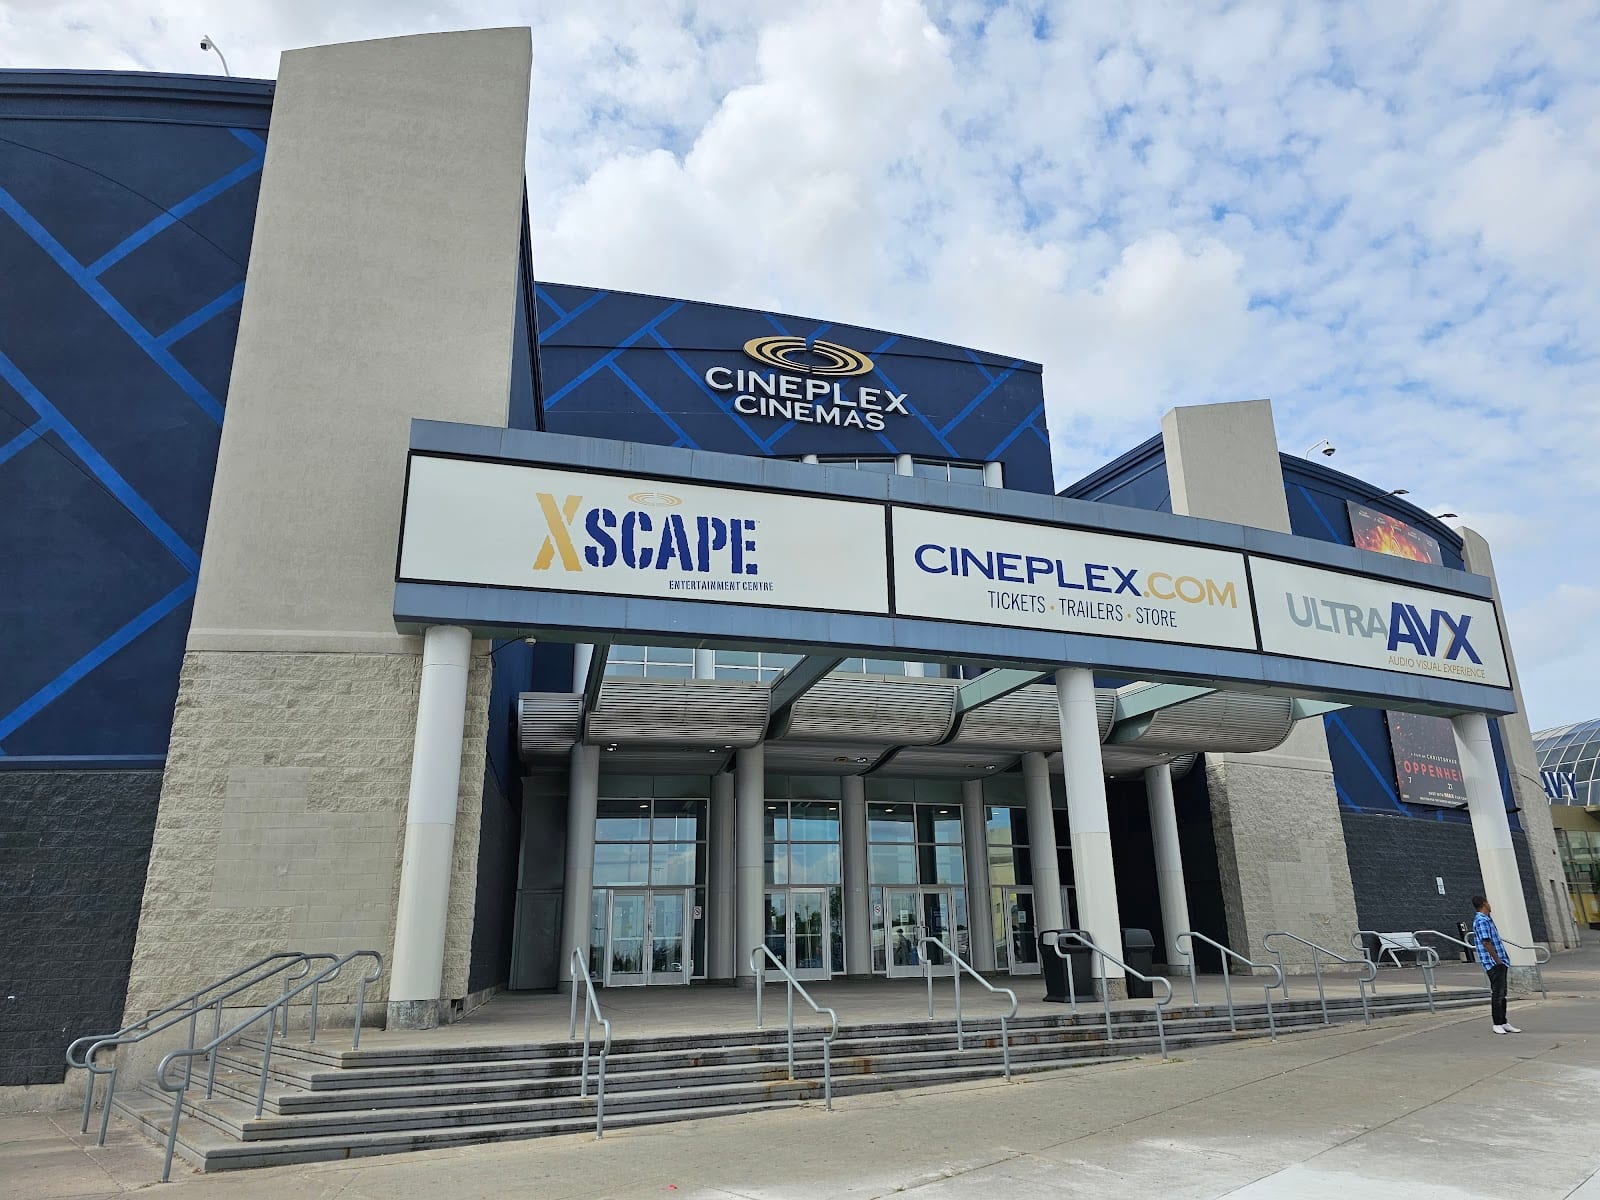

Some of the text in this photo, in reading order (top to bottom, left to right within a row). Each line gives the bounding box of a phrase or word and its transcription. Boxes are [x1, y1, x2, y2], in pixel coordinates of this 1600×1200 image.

[705, 366, 910, 415] CINEPLEX
[734, 394, 885, 431] CINEMAS
[533, 493, 758, 575] XSCAPE
[669, 580, 774, 592] ENTERTAINMENT CENTRE
[914, 543, 1237, 609] CINEPLEX.COM
[987, 590, 1178, 628] TICKETS TRAILERS STORE
[1388, 655, 1486, 679] AUDIO VISUAL EXPERIENCE
